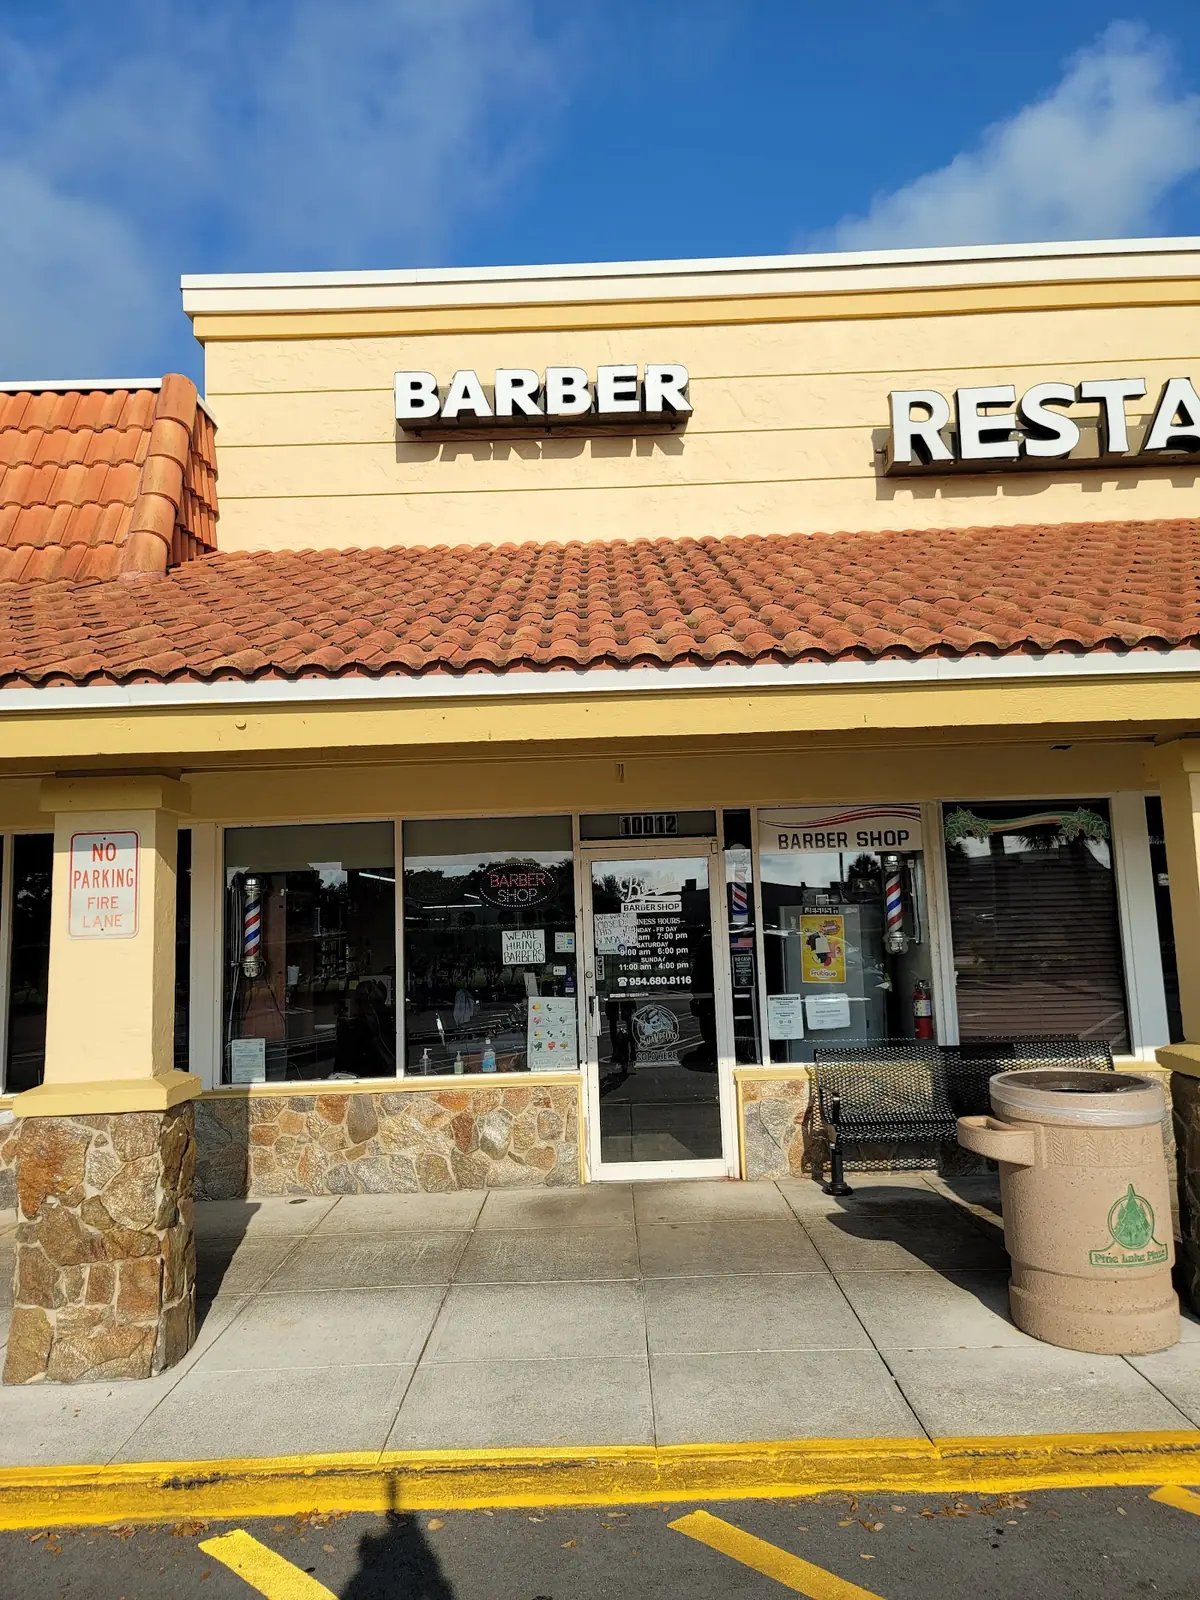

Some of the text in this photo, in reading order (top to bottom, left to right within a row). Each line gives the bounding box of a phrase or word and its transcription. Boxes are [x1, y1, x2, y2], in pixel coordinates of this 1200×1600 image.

[393, 363, 694, 420] BARBER
[887, 376, 1200, 463] RESTA
[620, 814, 677, 835] 10012
[778, 829, 909, 850] BARBER SHOP
[92, 842, 117, 862] NO
[73, 868, 134, 889] PARKING
[490, 872, 546, 888] BARBER
[497, 888, 538, 902] SHOP
[87, 896, 119, 910] FIRE
[623, 903, 680, 911] BARBER SHOP
[82, 913, 123, 929] LANE
[504, 930, 539, 941] WE ARE
[638, 933, 650, 941] am
[657, 932, 673, 940] 7:00
[675, 932, 688, 941] pm
[505, 939, 542, 951] HIRING
[637, 941, 669, 949] SATURDAY
[657, 947, 674, 955] 6:00
[675, 947, 689, 955] pm
[503, 948, 545, 963] BARBERS
[618, 963, 638, 971] 11:00
[658, 962, 675, 970] 4:00
[676, 962, 689, 971] pm
[629, 976, 692, 986] 954.680.8116
[636, 1050, 678, 1061] SOLD HERE
[1094, 1253, 1118, 1264] Pine
[1122, 1253, 1145, 1264] Lake
